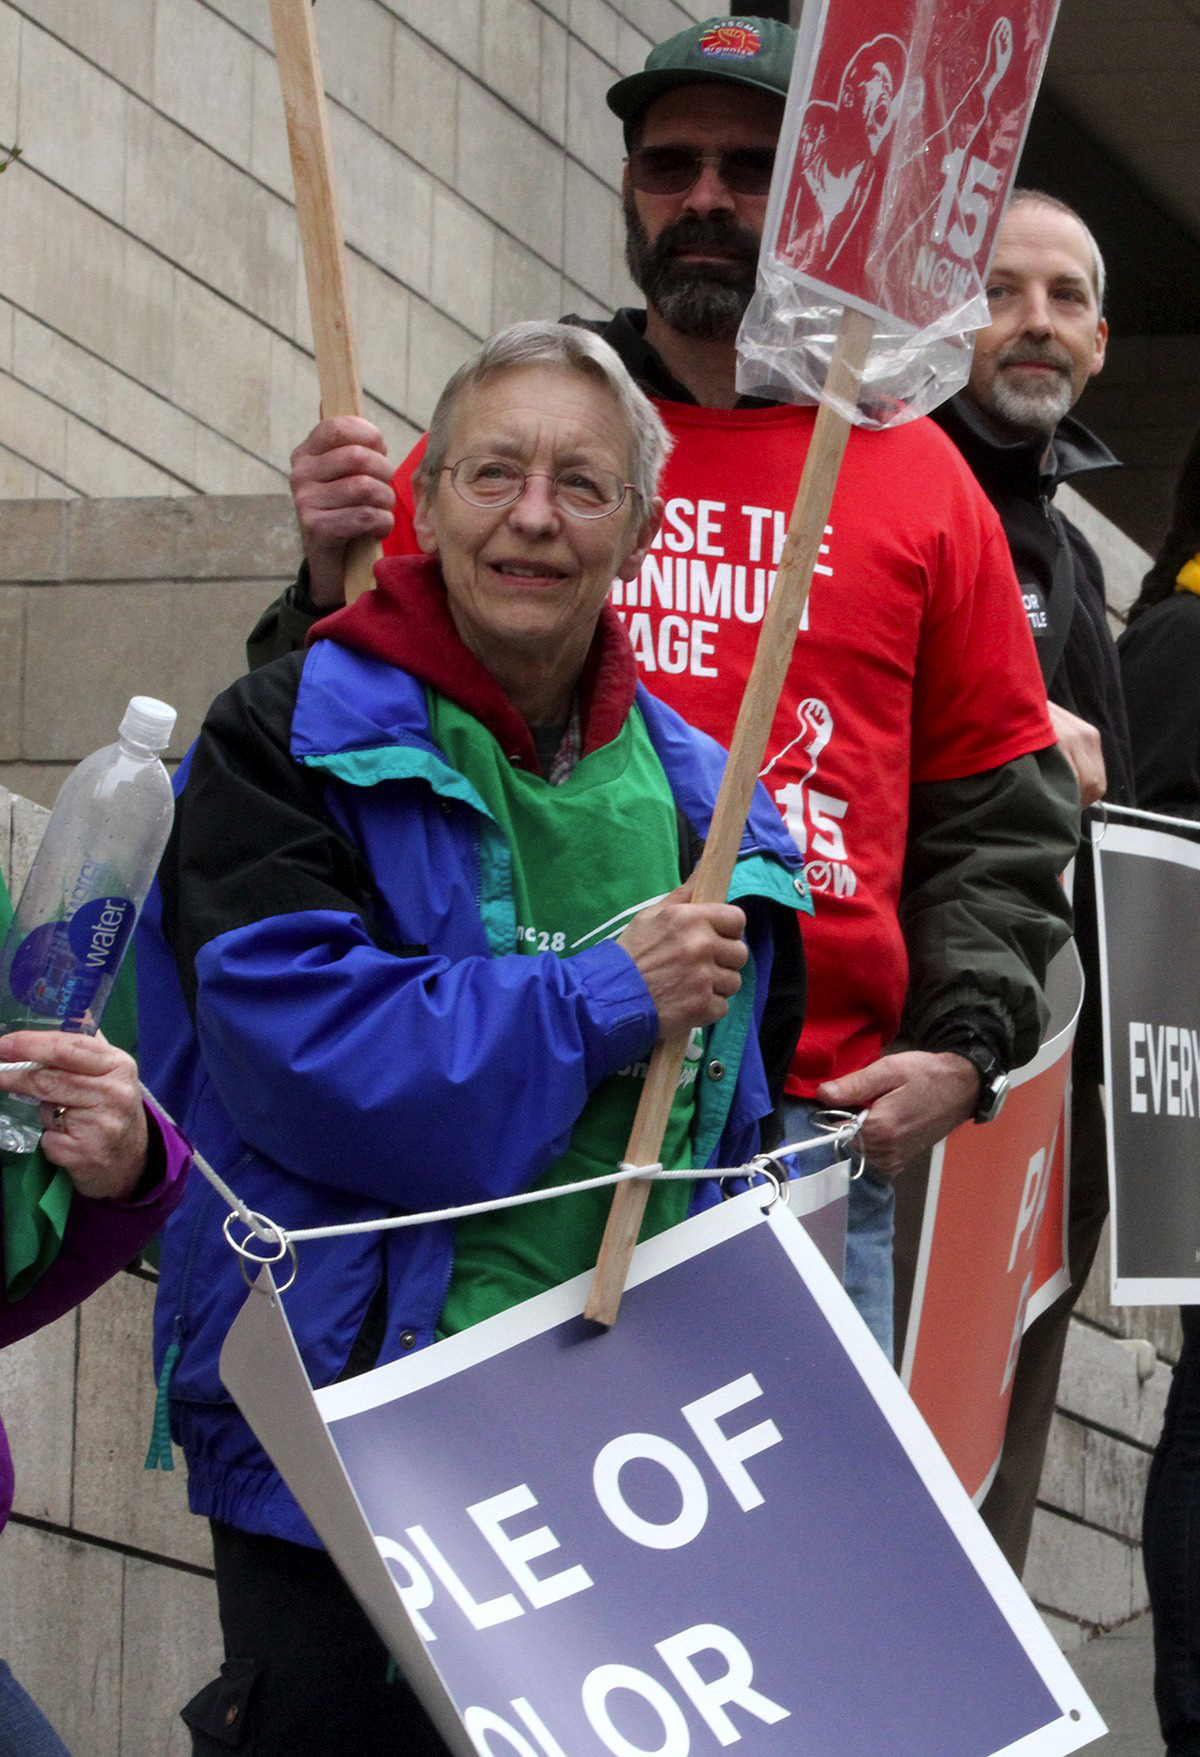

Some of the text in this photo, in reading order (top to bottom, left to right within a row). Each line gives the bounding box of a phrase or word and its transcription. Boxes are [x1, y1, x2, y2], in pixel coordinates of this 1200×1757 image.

[930, 147, 999, 258] 15
[912, 246, 974, 305] NOW
[651, 497, 726, 557] SE
[611, 553, 810, 631] INIMU
[618, 611, 719, 678] AGE
[774, 782, 849, 861] 15
[593, 1372, 784, 1550] OF
